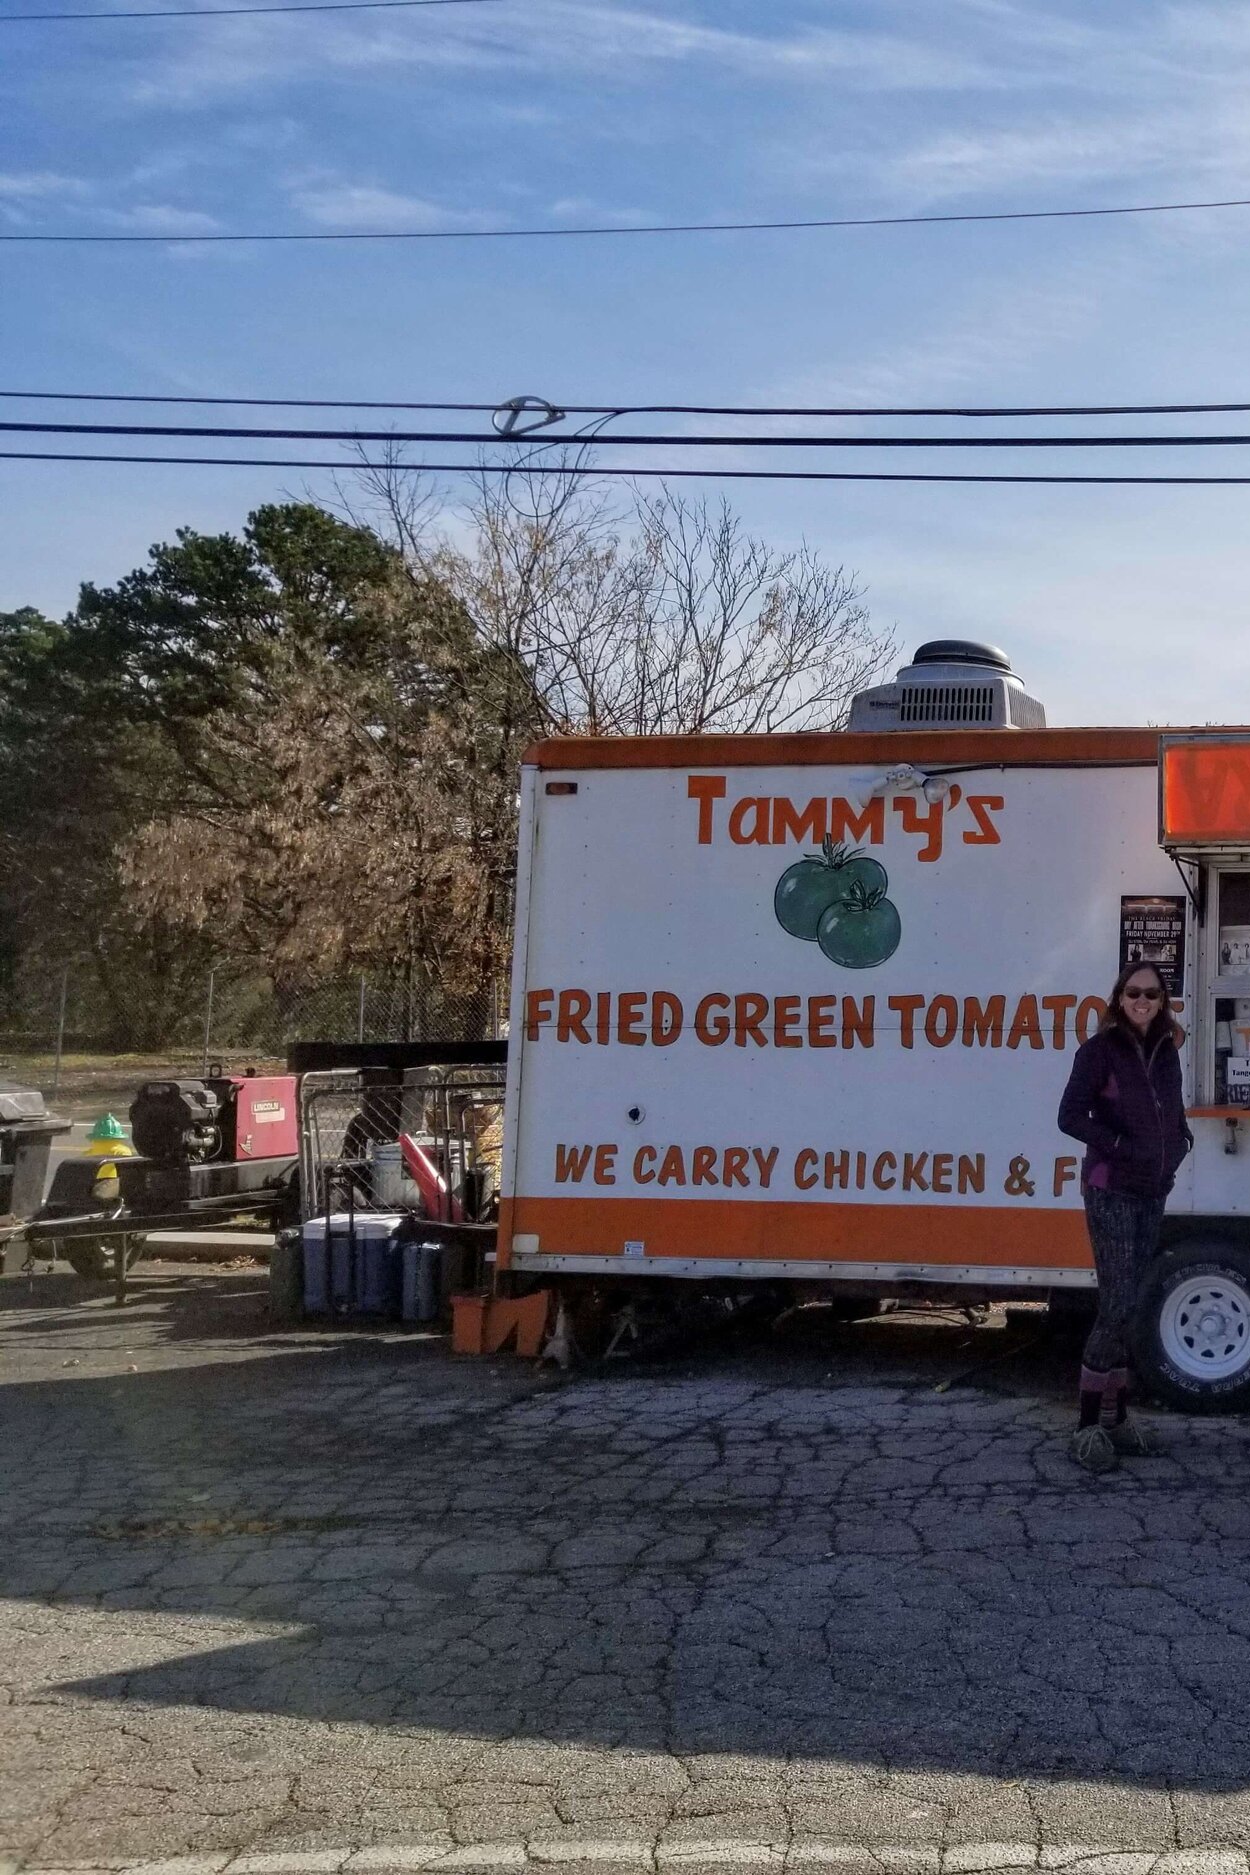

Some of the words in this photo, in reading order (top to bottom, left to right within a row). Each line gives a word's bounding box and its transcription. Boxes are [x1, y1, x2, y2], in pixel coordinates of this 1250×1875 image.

[1144, 930, 1169, 938] NOVEMBER
[527, 989, 683, 1047] FRIED
[695, 992, 875, 1050] GREEN
[888, 992, 1186, 1052] TOMATO
[253, 1102, 279, 1112] LINCOLN
[554, 1143, 618, 1186] WE
[632, 1144, 779, 1189] CARRY
[794, 1147, 986, 1194] CHICKEN
[1004, 1155, 1036, 1197] &
[1053, 1156, 1086, 1197] F
